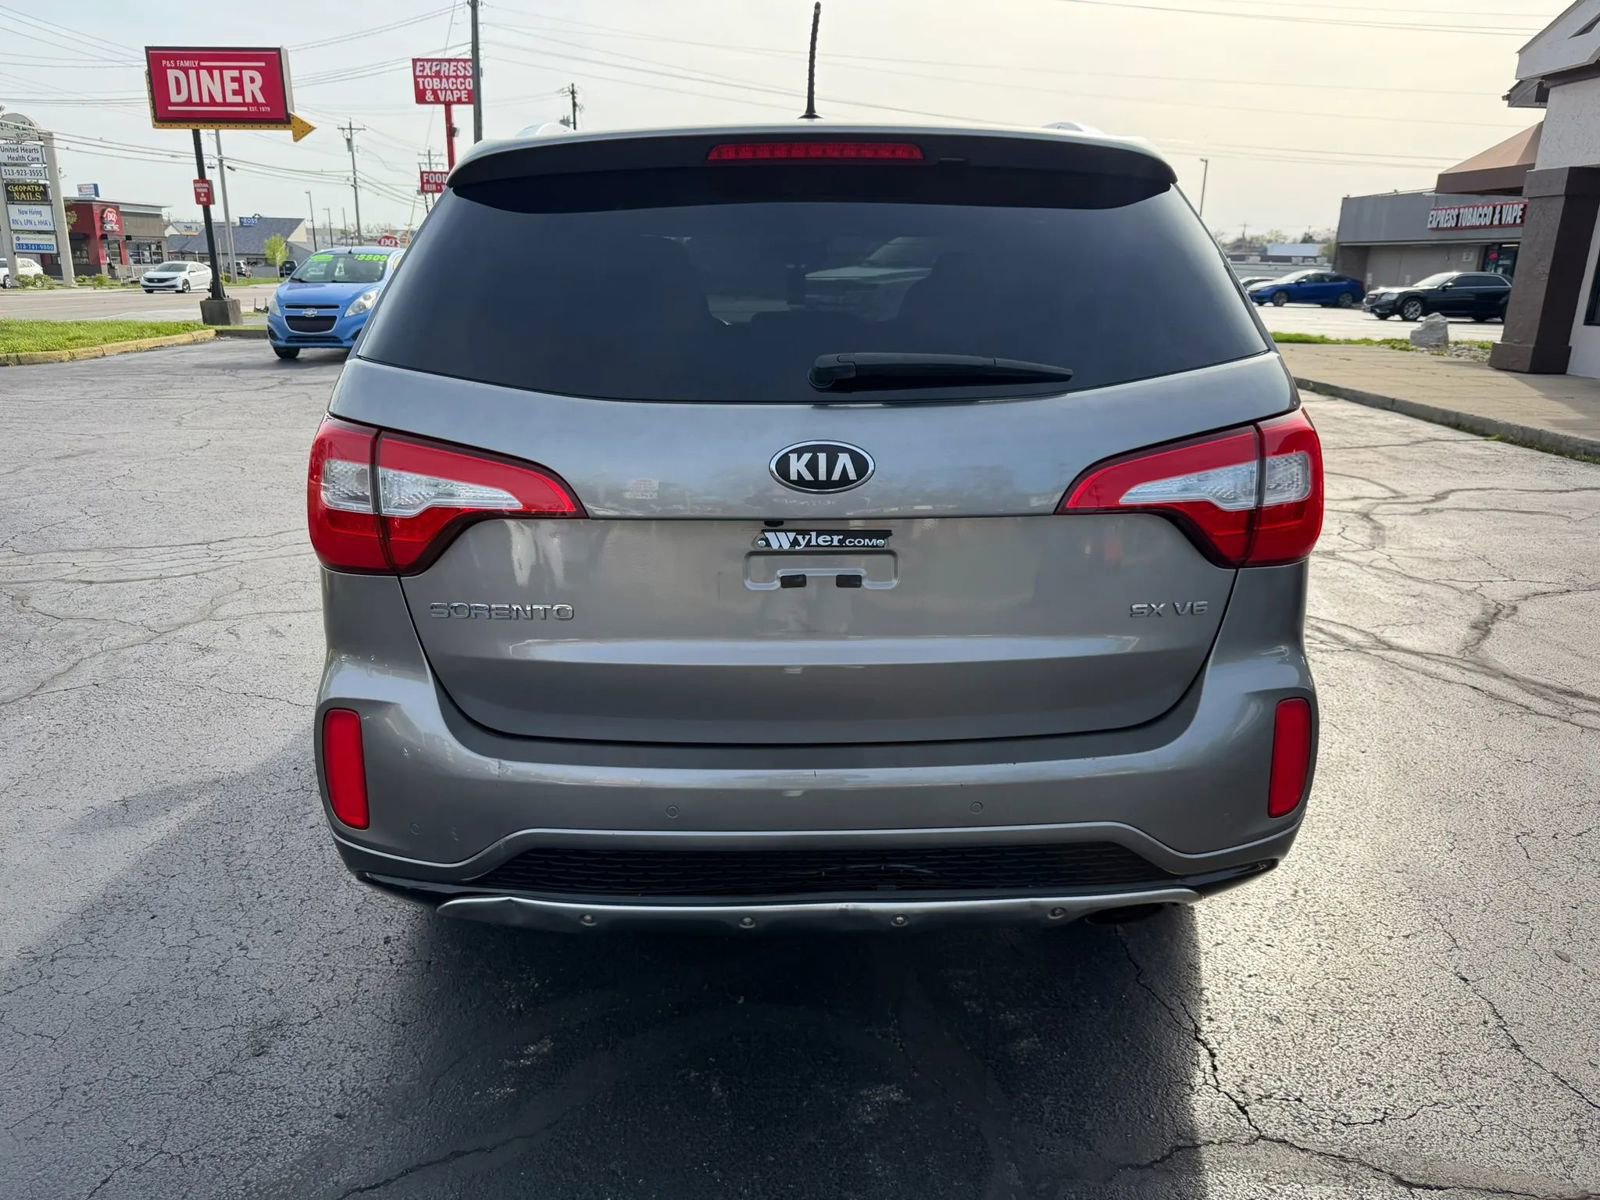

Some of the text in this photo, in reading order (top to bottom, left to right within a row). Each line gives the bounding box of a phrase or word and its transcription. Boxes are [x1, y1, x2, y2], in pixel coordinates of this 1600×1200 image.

[415, 62, 473, 77] EXPRESS
[166, 69, 266, 104] DINER
[417, 78, 474, 90] TOBACCO
[425, 90, 469, 102] & VAPE
[13, 192, 42, 201] NAILS
[1427, 203, 1523, 228] EXPRESS TOBACCO & VAPE
[788, 452, 857, 481] KIA
[430, 602, 575, 620] SORENTO
[1129, 603, 1166, 617] SX
